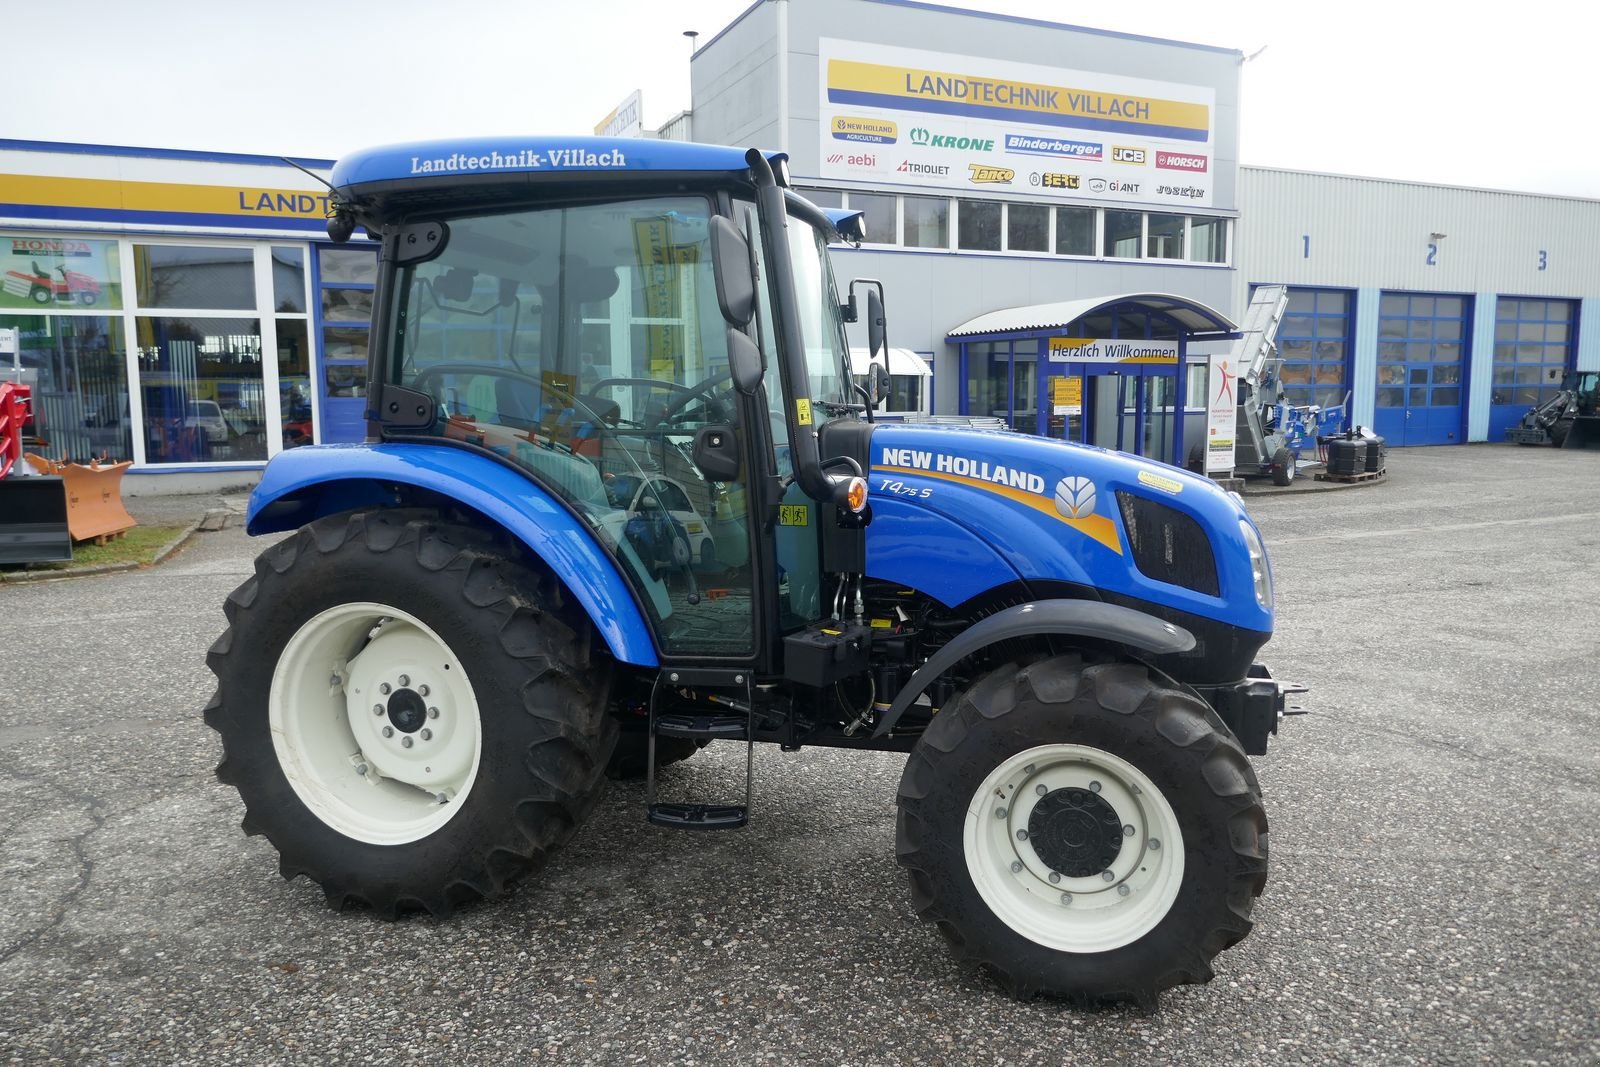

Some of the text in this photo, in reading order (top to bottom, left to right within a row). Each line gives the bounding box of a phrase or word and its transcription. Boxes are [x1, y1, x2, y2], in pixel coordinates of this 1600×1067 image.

[906, 73, 1150, 119] LANDTECHNIK VILLACH
[847, 123, 893, 133] NEW HOLLAND
[846, 133, 883, 143] AGRICULTURE
[931, 135, 995, 152] KRONE
[1007, 135, 1101, 157] Binderberger
[411, 149, 626, 174] Landtechnik-Villach
[847, 153, 876, 167] aebi
[1113, 148, 1146, 163] JCB
[1166, 156, 1205, 169] HORSCH
[908, 163, 950, 175] TRIOLIET
[968, 163, 1015, 183] Tanco
[12, 240, 92, 252] HONDA
[1302, 235, 1310, 259] 1
[1426, 243, 1438, 266] 2
[1538, 250, 1547, 271] 3
[1052, 344, 1176, 359] Herzlich Willkommen
[882, 448, 1045, 494] NEW HOLLAND
[919, 488, 934, 498] S
